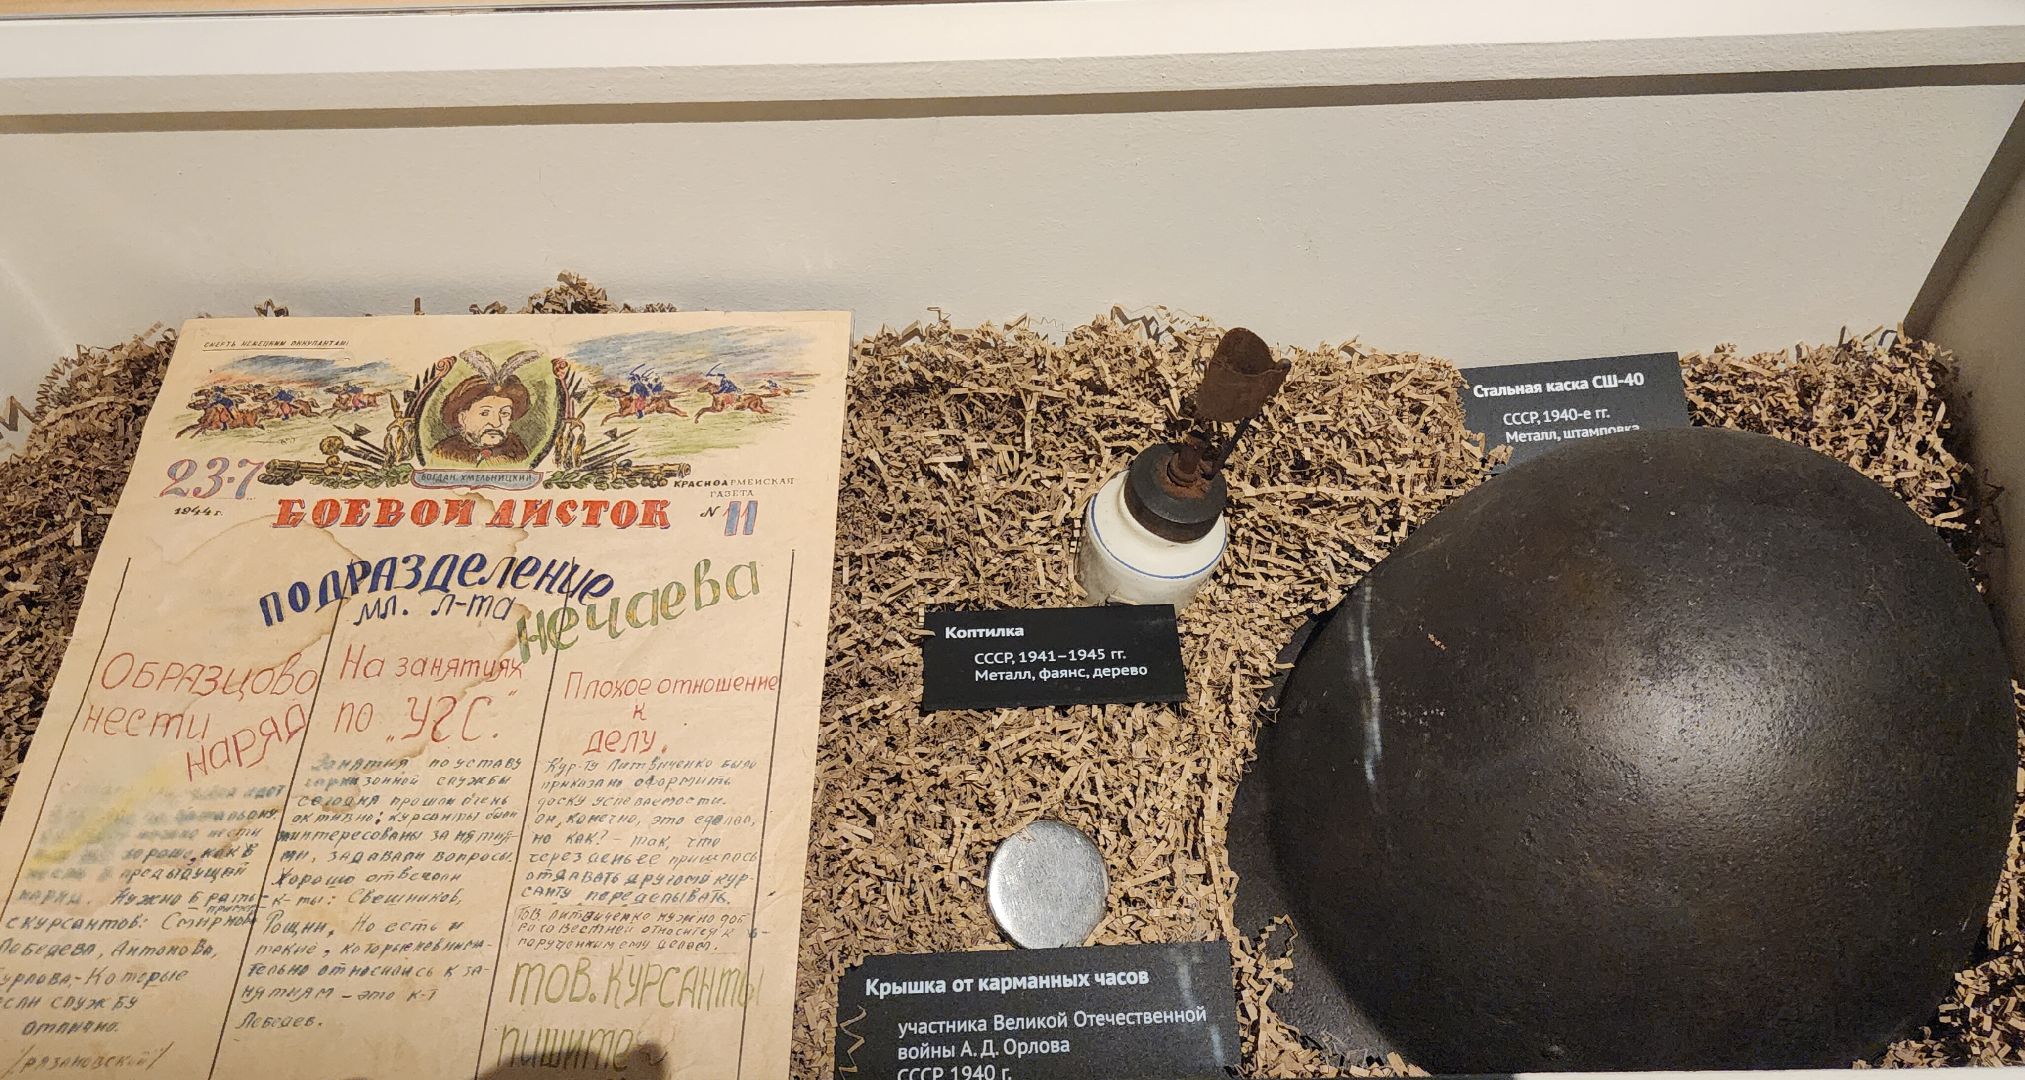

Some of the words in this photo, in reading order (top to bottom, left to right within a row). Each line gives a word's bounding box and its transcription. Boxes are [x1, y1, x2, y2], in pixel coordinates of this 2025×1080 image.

[1473, 381, 1542, 398] Стальная
[1546, 378, 1589, 392] каска
[1592, 372, 1645, 390] СШ-40
[1502, 410, 1541, 426] СССР,
[1543, 408, 1592, 423] 1940-е
[1596, 408, 1611, 420] гг.
[1505, 429, 1561, 443] Металл,
[710, 489, 755, 499] ГАЗЕТА
[485, 498, 672, 530] ЛИСТОК
[944, 625, 1025, 639] Коптилка
[339, 643, 386, 681] На
[395, 656, 524, 682] занятиях
[974, 651, 1016, 665] СССР,
[1110, 649, 1127, 660] гг.
[974, 669, 1036, 682] Металл,
[1038, 666, 1090, 682] фаянс,
[1092, 664, 1148, 679] дерево
[564, 671, 652, 700] Плохое
[657, 674, 779, 695] отношение
[865, 976, 947, 1000] Крышка
[951, 977, 975, 993] от
[977, 971, 1091, 995] карманных
[1094, 968, 1150, 987] часов
[897, 1017, 988, 1038] участника
[993, 1010, 1068, 1031] Великой
[1073, 1004, 1207, 1028] Отечественной
[898, 1042, 956, 1060] войны
[960, 1040, 978, 1057] А.
[979, 1039, 1001, 1059] Д.
[1002, 1036, 1071, 1058] Орлова
[897, 1066, 944, 1080] СССР
[950, 1064, 996, 1080] 1940
